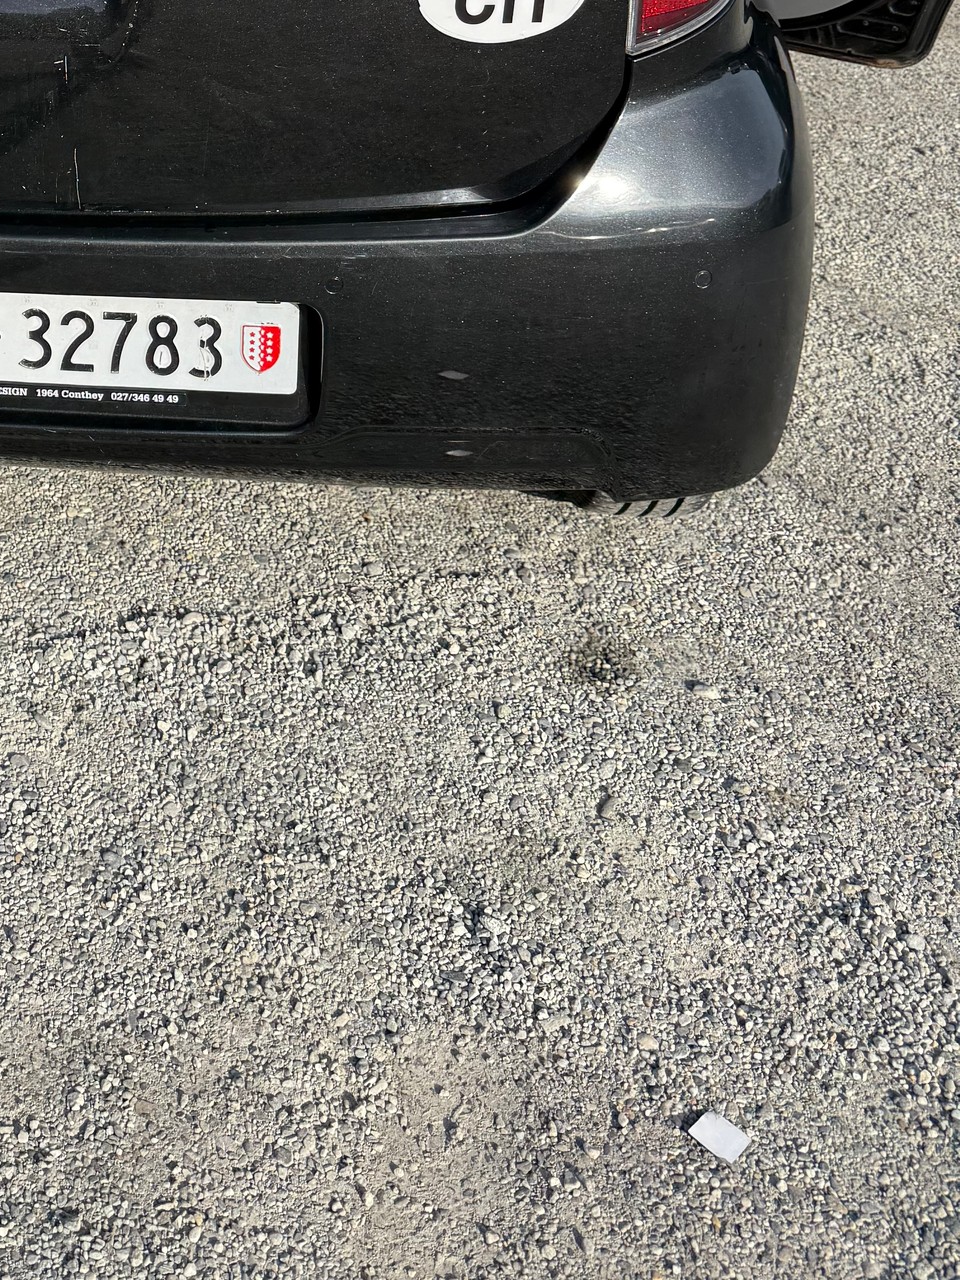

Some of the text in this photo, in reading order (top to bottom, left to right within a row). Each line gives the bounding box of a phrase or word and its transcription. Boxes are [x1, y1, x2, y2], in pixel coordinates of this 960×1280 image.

[18, 308, 223, 379] 32783
[36, 389, 59, 398] 1964
[61, 390, 104, 402] Conthey
[110, 392, 150, 402] 027/346
[151, 394, 165, 403] 49
[166, 395, 179, 404] 49
